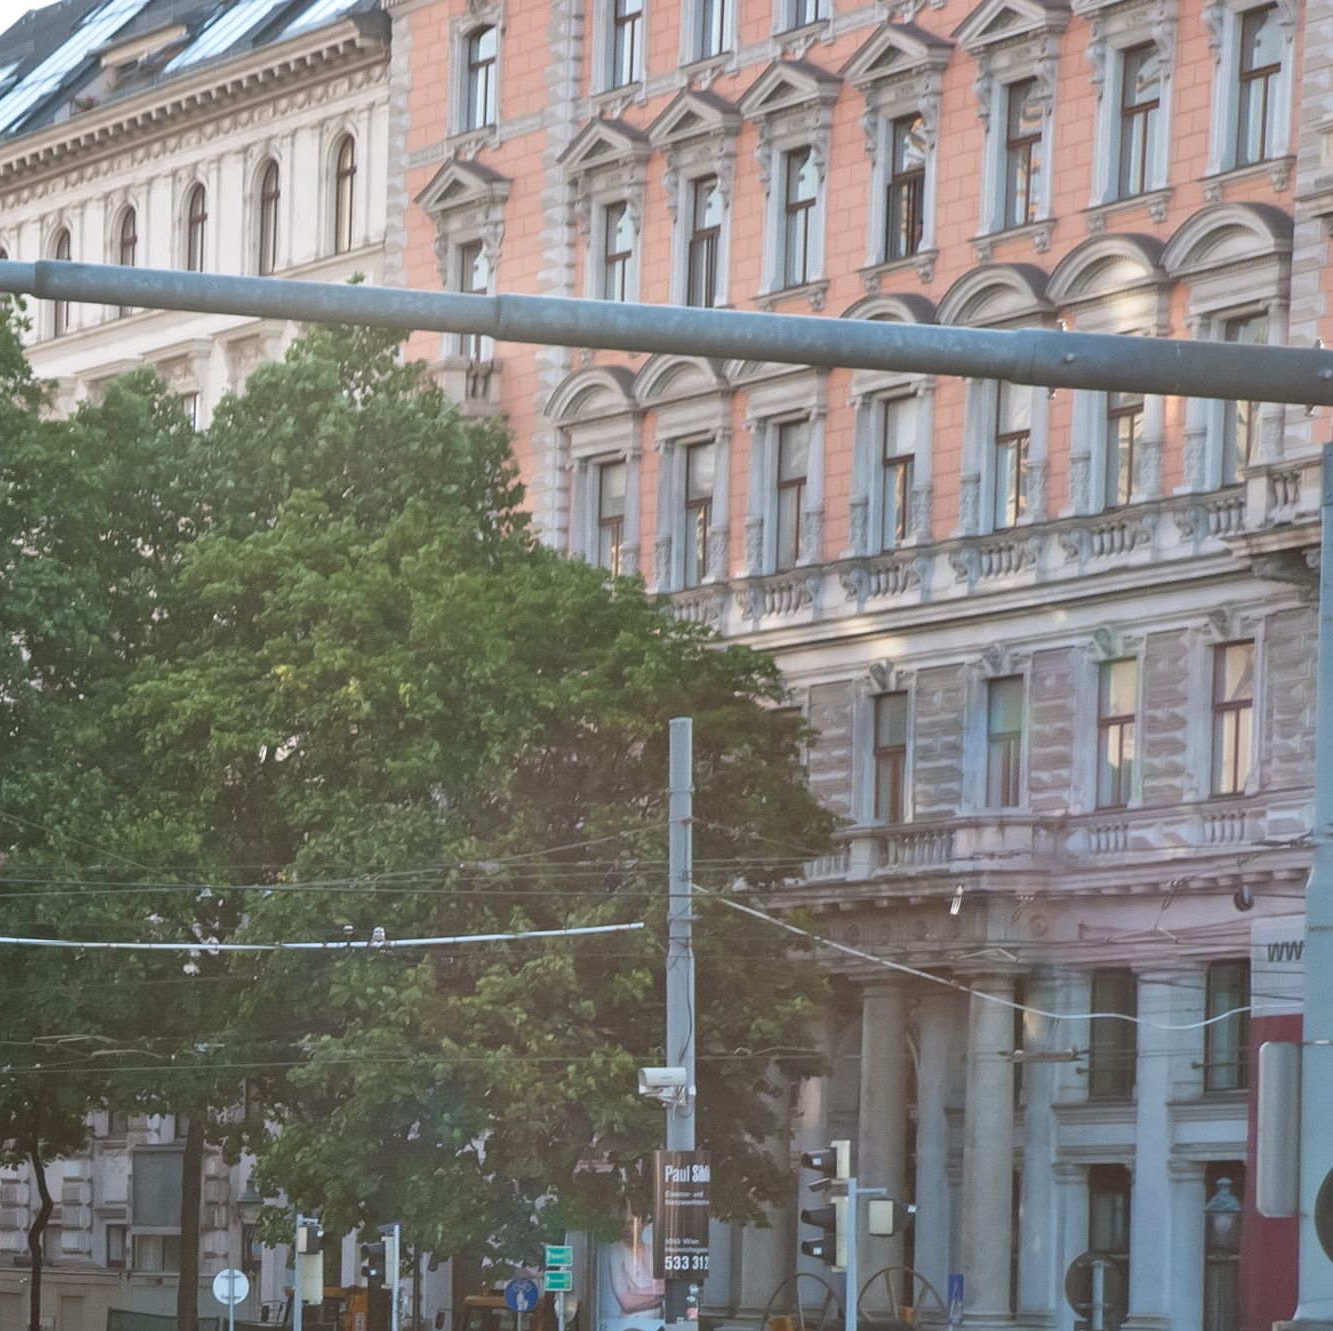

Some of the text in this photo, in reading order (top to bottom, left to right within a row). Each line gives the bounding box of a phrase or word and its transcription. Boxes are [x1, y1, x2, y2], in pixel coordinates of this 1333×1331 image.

[665, 1165, 690, 1183] Paul
[664, 1255, 710, 1270] 533 312
